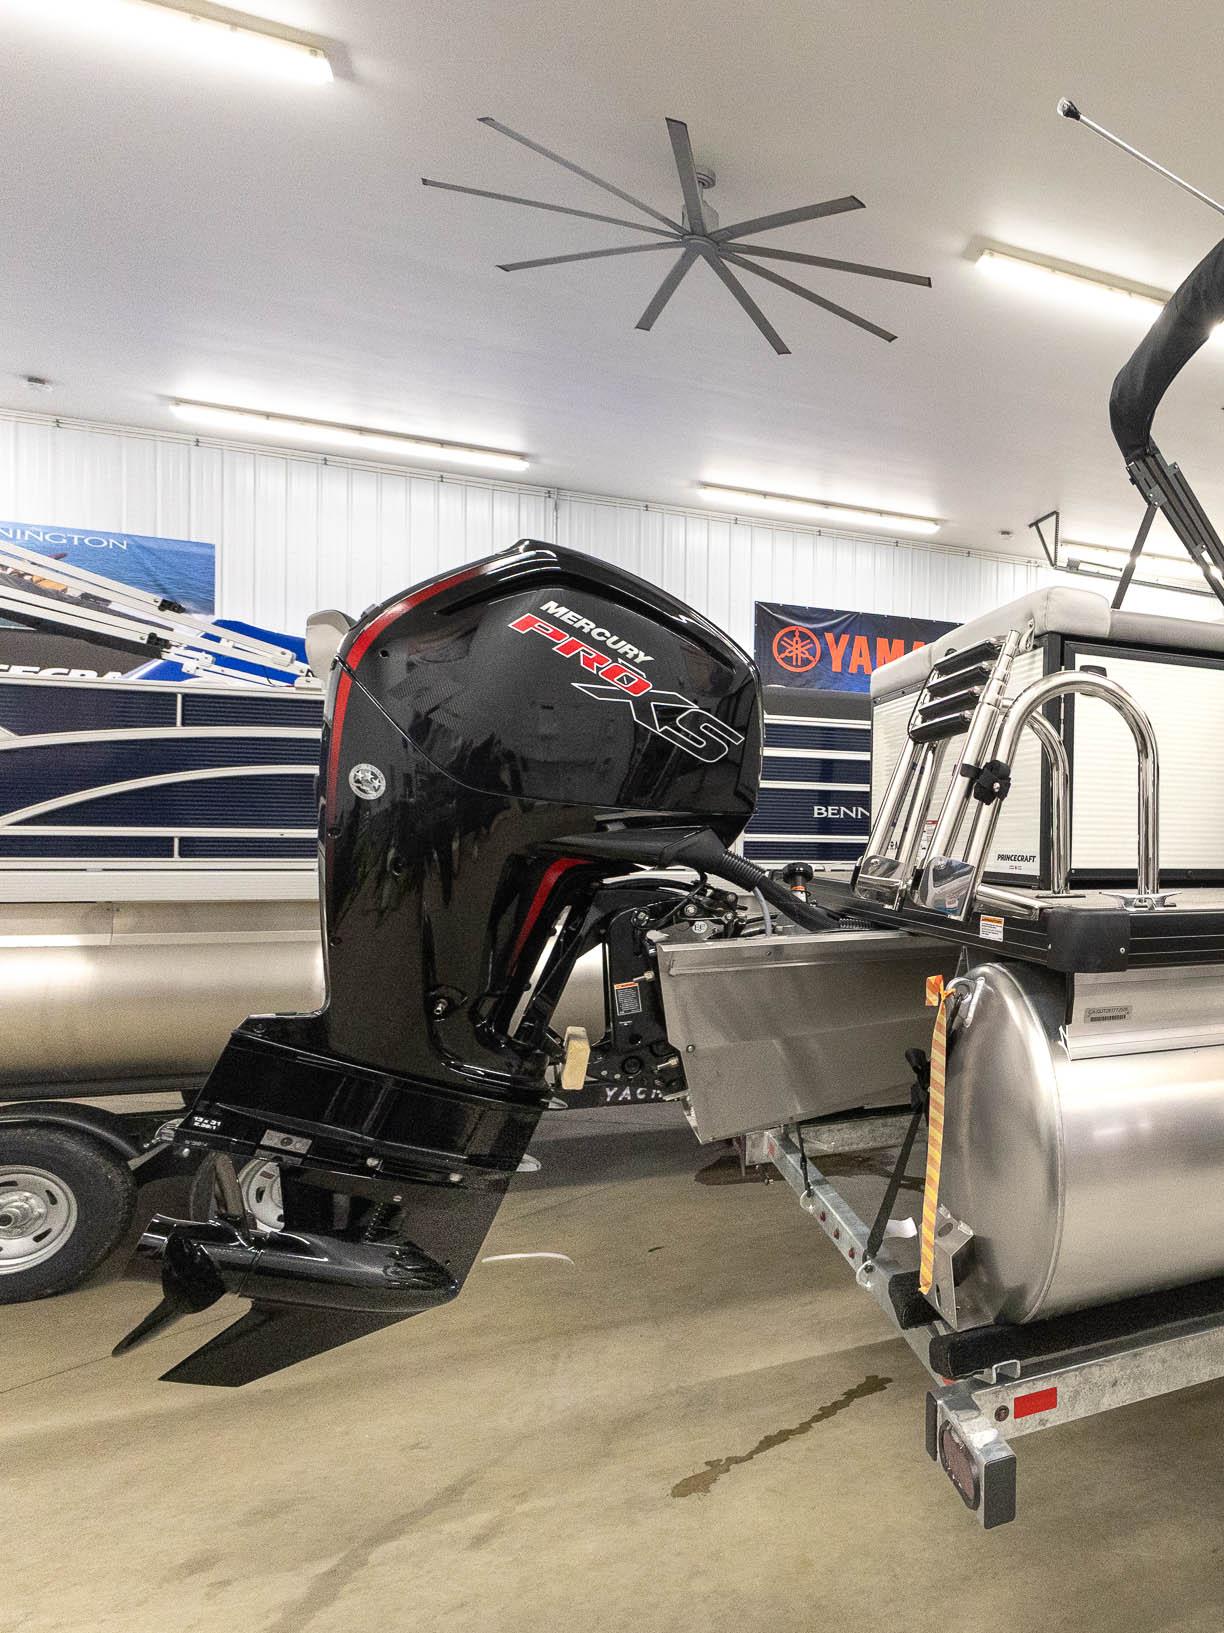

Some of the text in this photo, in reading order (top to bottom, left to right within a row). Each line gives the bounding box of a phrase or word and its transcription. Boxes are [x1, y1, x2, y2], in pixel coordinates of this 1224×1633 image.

[507, 612, 653, 697] PRO
[540, 600, 655, 664] MERCURY
[824, 632, 925, 675] YAM
[997, 853, 1036, 863] PRINCECRAFT
